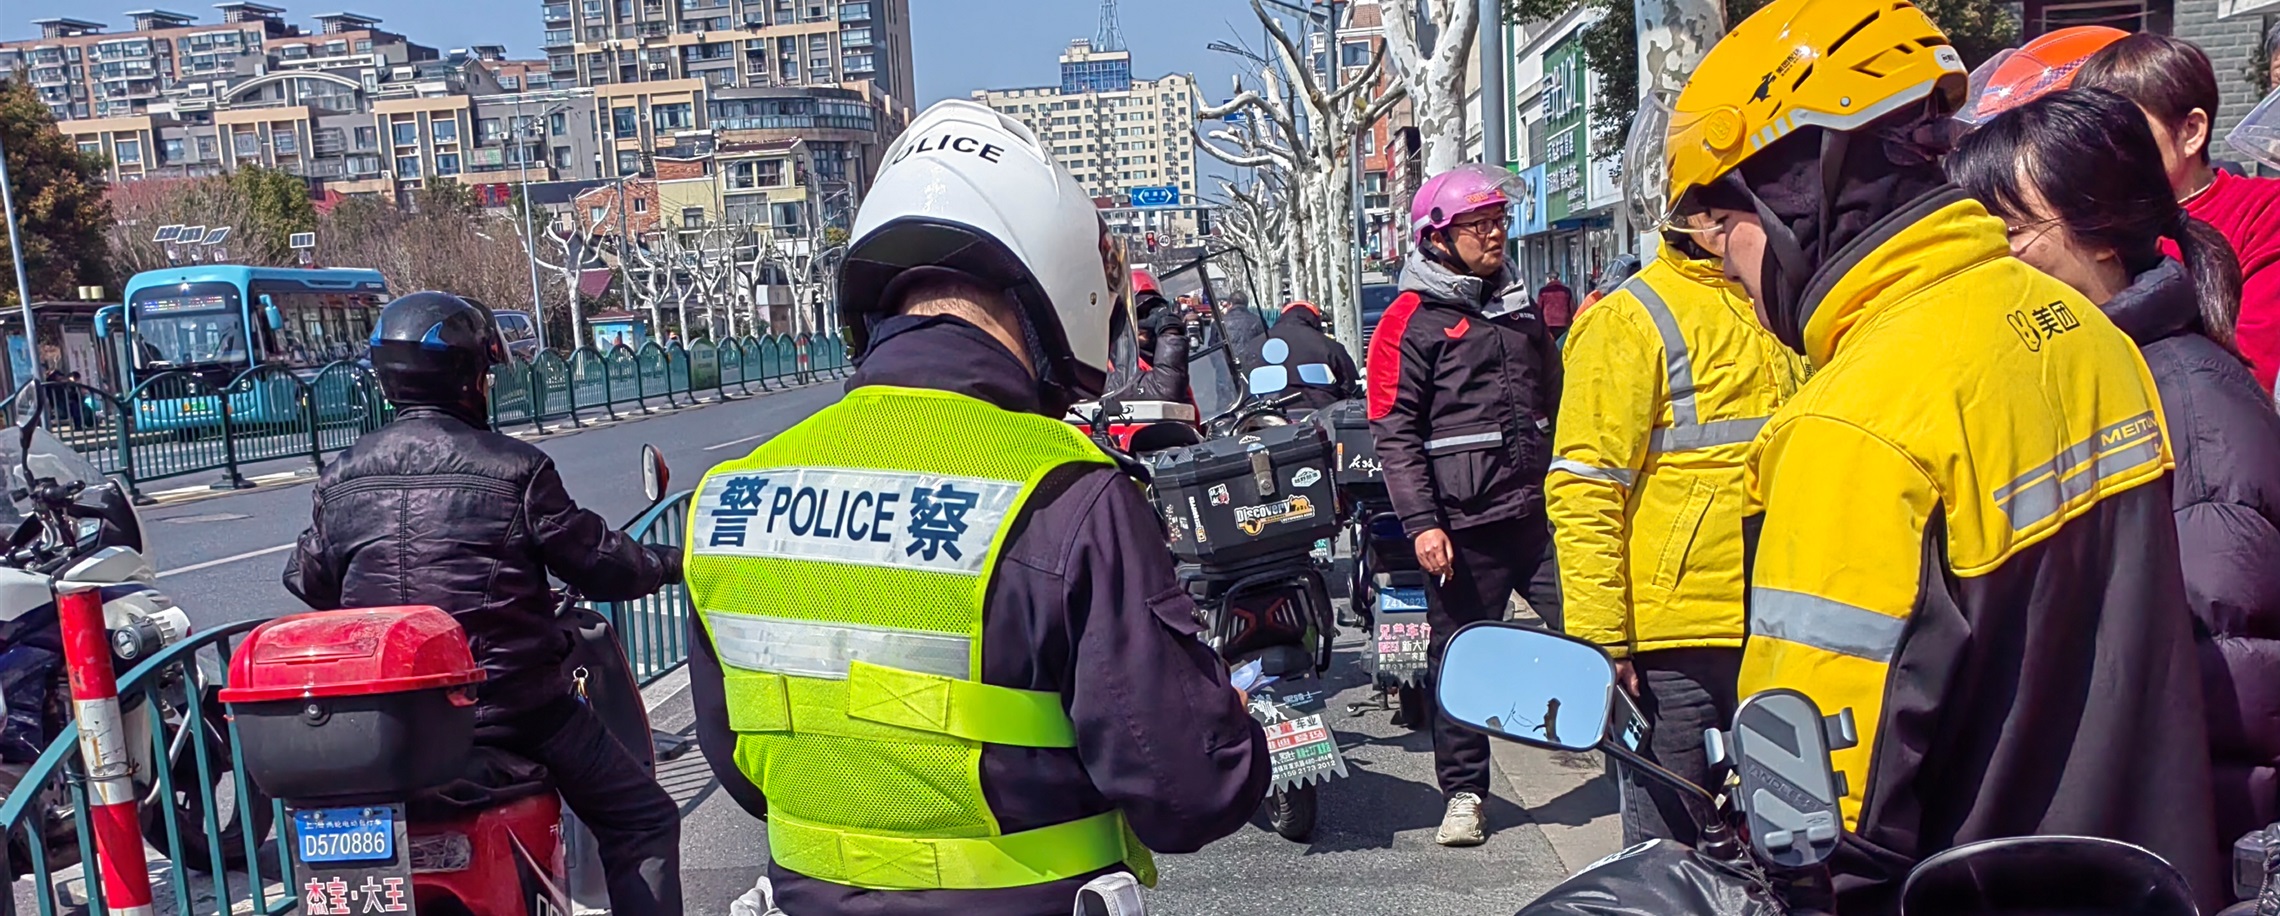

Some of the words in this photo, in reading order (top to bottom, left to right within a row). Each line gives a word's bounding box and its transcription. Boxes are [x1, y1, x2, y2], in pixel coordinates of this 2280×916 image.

[2032, 300, 2080, 340] 美团
[709, 475, 770, 548] 警
[766, 486, 900, 543] POLICE
[905, 484, 980, 562] 察
[1298, 765, 1316, 774] 2173
[1318, 760, 1336, 770] 2012
[305, 831, 385, 857] D570886
